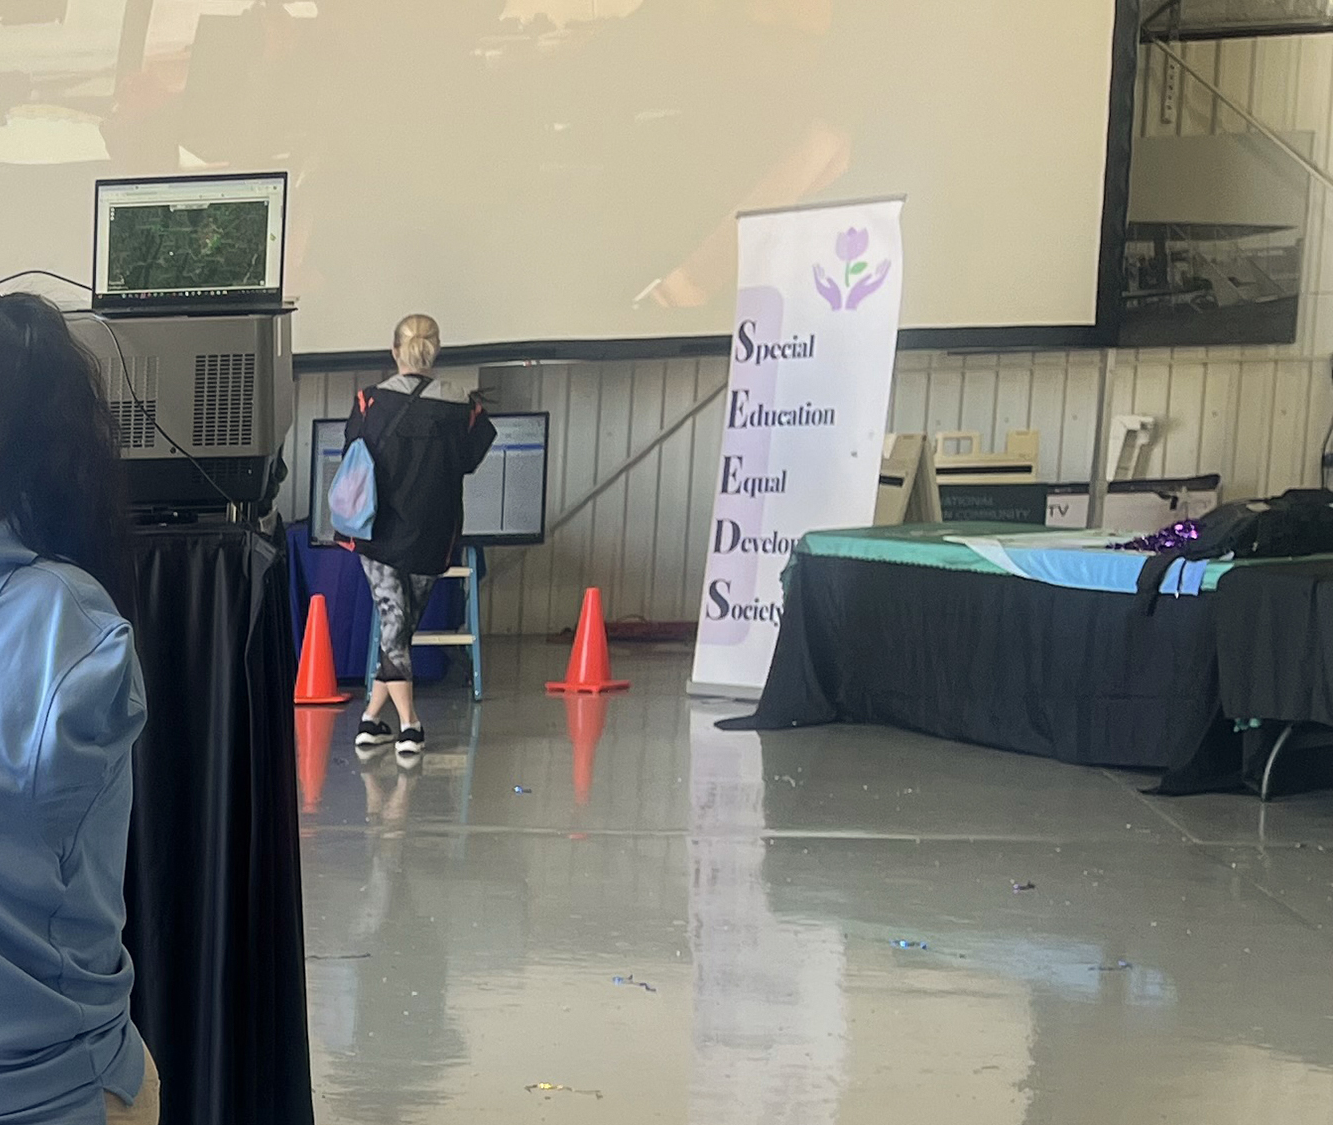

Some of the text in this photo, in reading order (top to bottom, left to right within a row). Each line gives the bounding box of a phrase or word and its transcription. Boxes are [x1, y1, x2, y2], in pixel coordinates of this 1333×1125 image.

[735, 319, 816, 366] Special
[726, 389, 836, 430] Education
[720, 455, 787, 499] Equal
[1048, 503, 1069, 518] TV
[705, 578, 784, 627] Society
